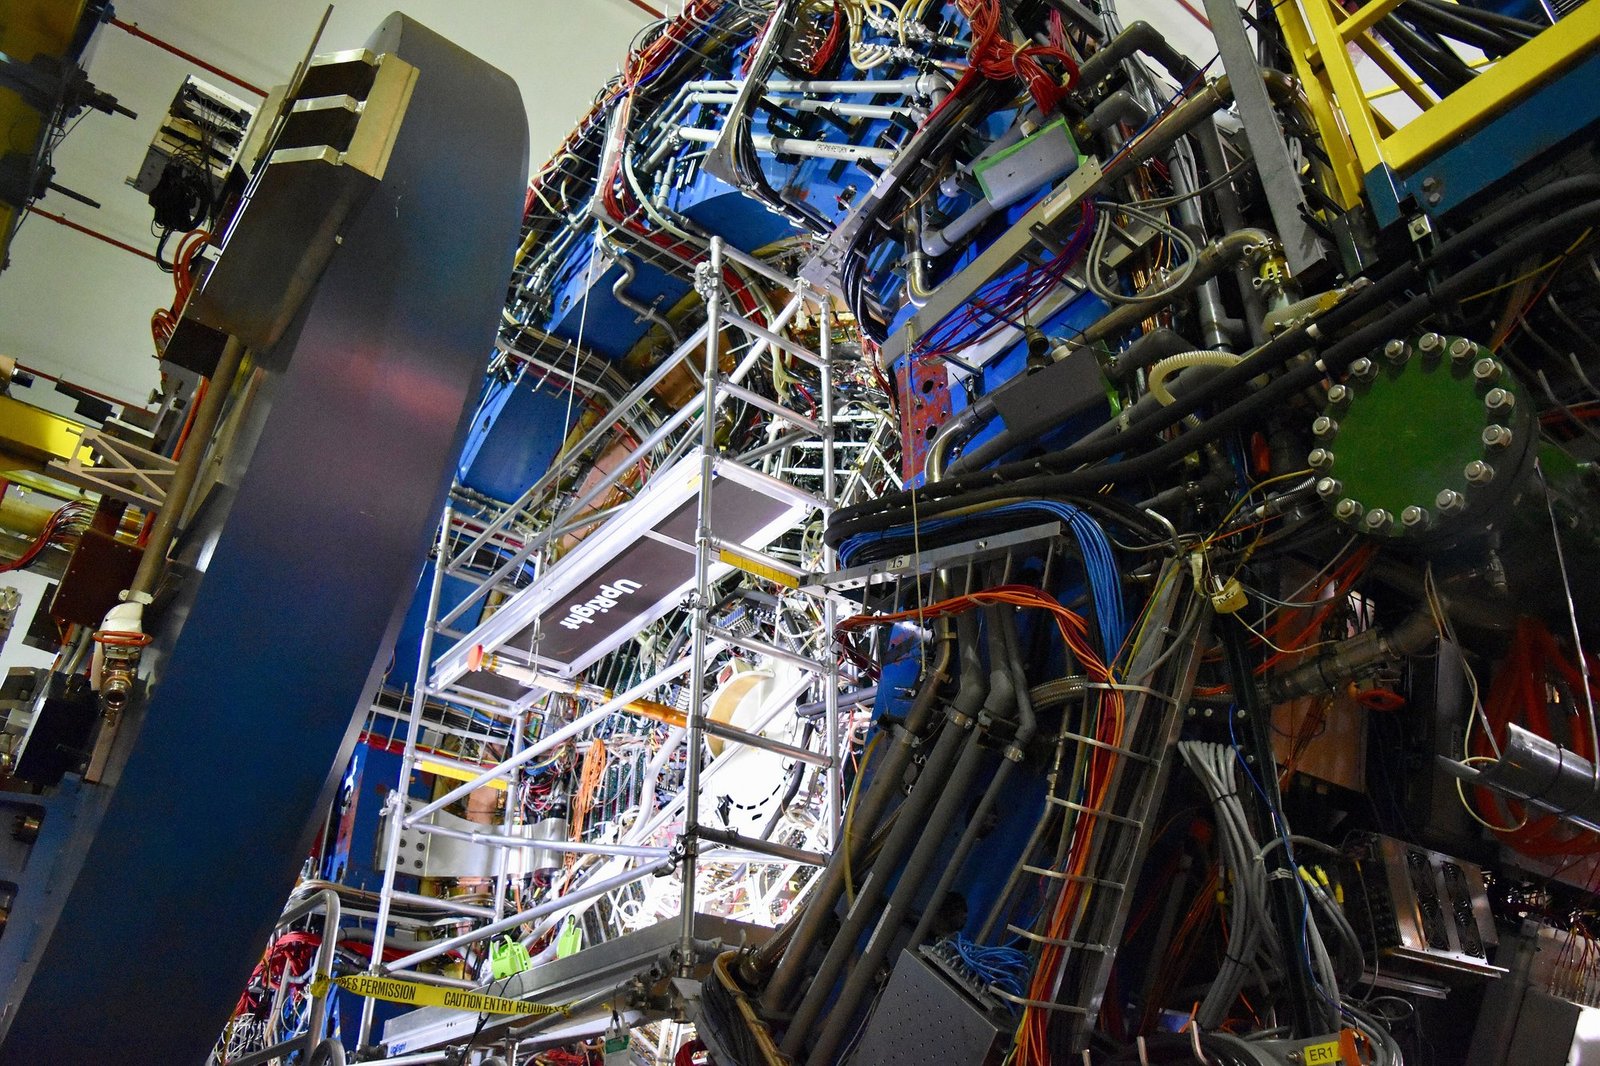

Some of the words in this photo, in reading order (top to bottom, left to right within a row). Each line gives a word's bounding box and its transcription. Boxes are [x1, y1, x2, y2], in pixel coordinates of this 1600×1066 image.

[560, 579, 643, 630] UpRight
[360, 979, 417, 1001] PERMISSION
[444, 991, 481, 1009] CAUTION
[483, 997, 514, 1012] ENTRY
[1309, 1046, 1334, 1062] ER1
